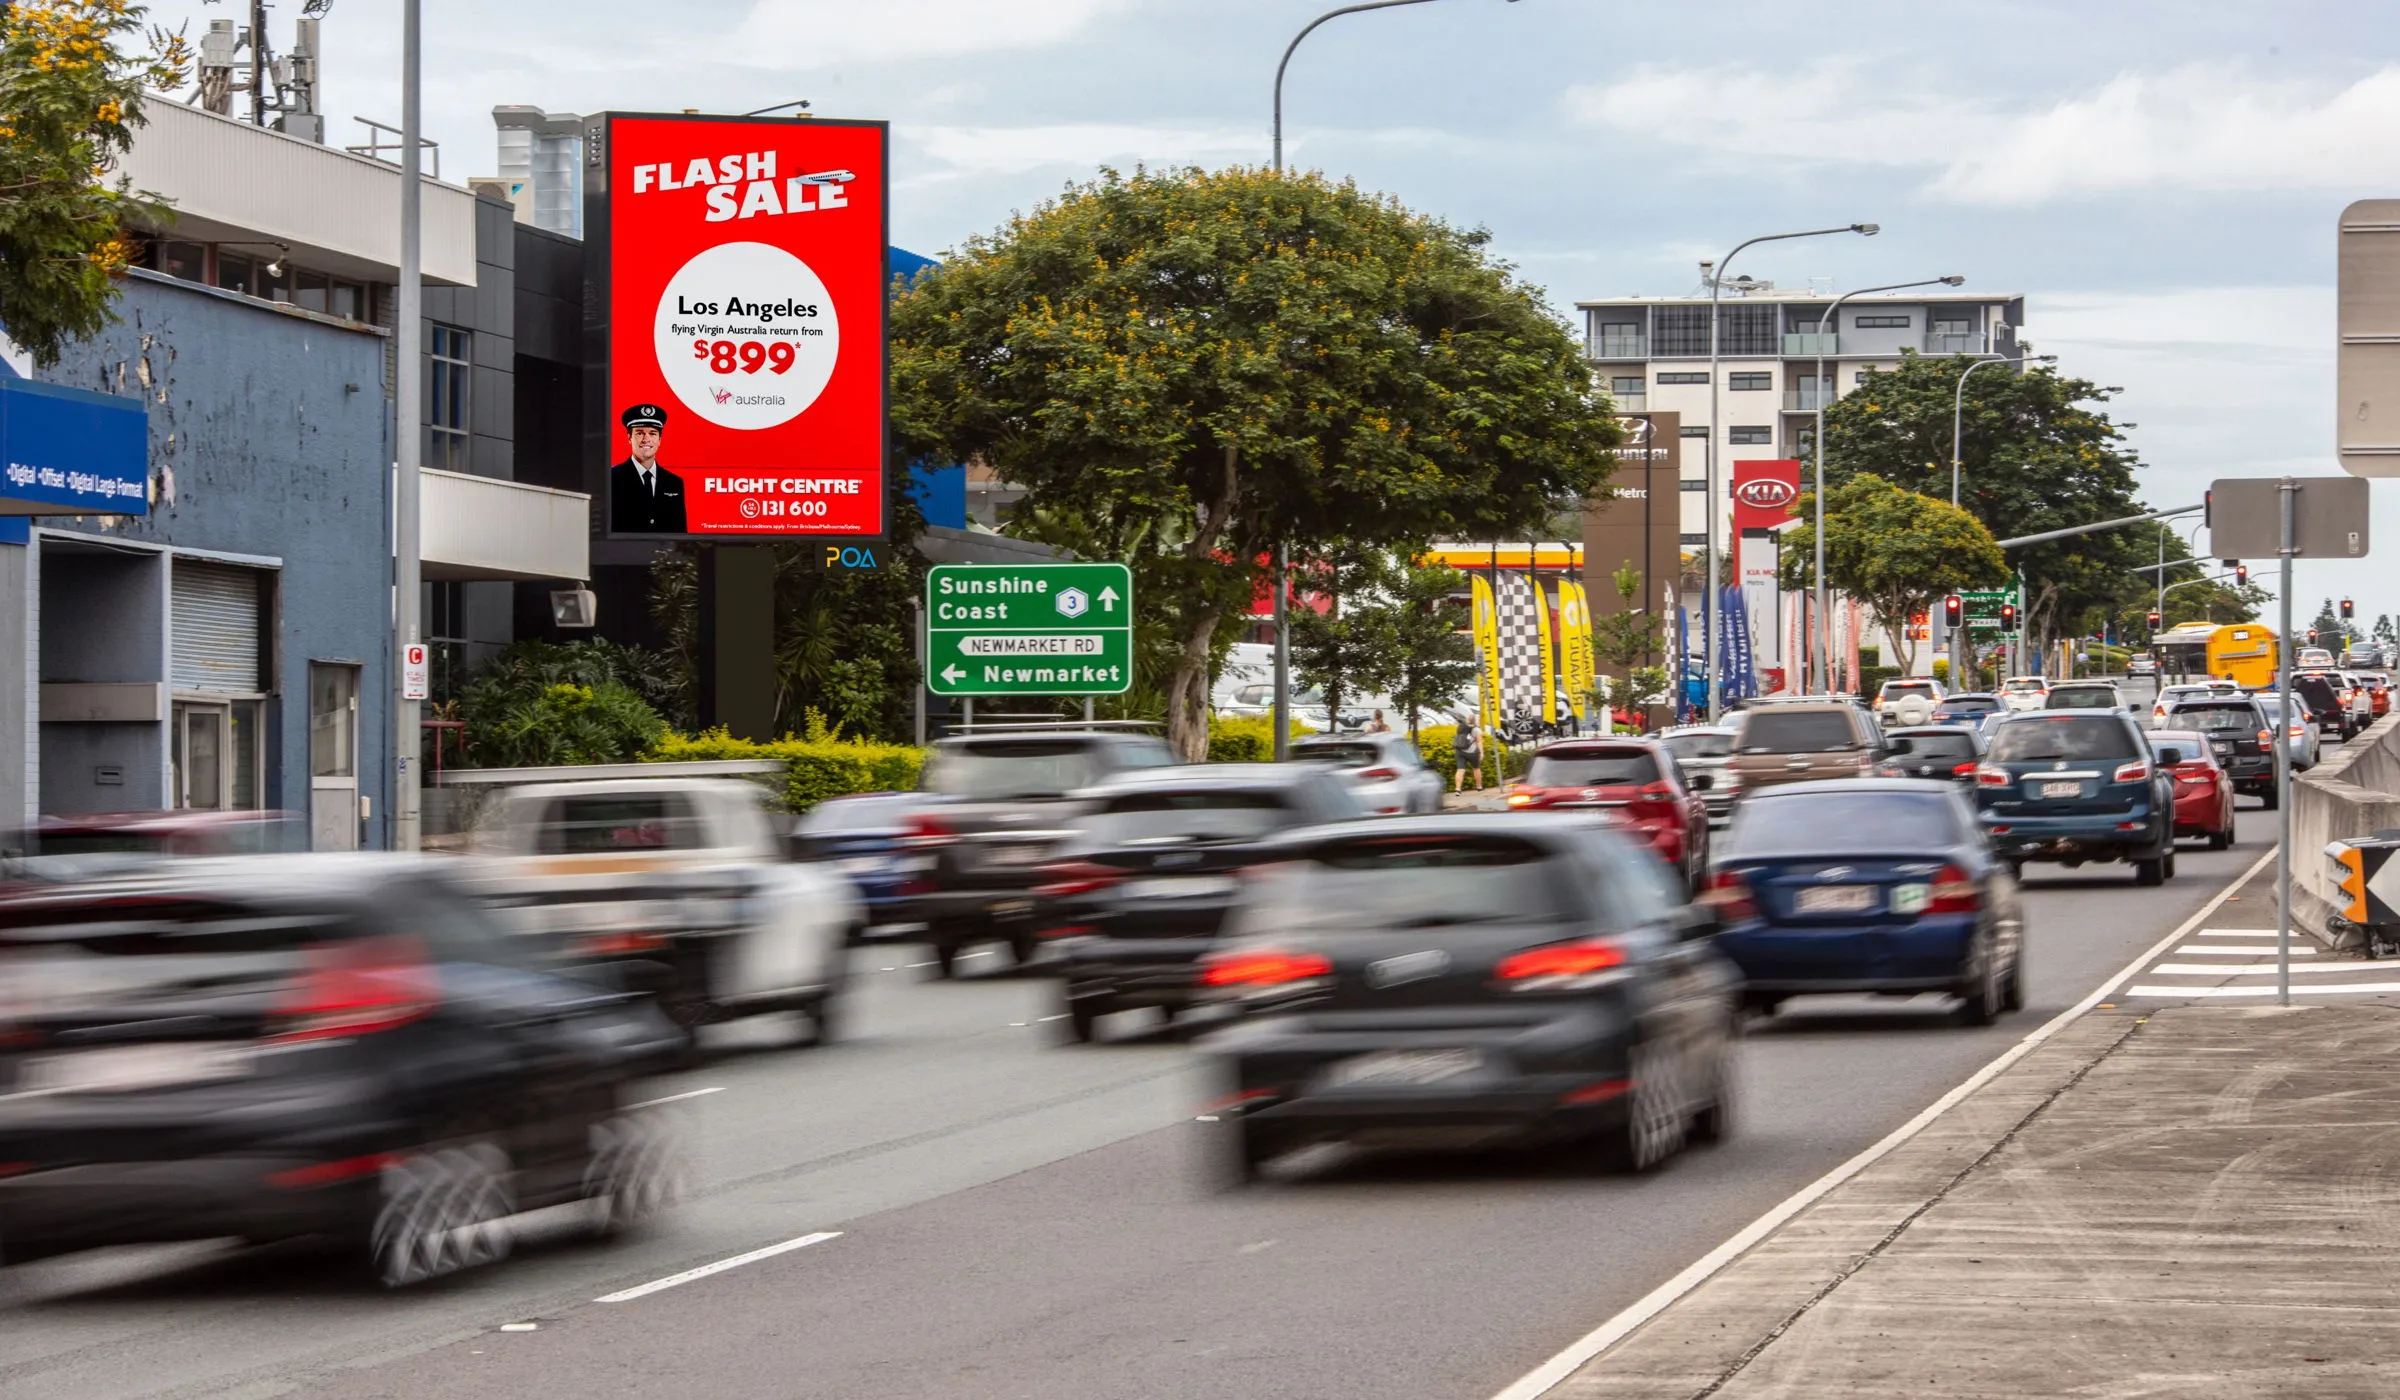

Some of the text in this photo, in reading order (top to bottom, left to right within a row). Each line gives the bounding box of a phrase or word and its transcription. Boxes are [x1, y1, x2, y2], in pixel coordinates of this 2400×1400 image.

[633, 150, 777, 194] FLASH
[704, 177, 849, 223] SALE
[678, 295, 818, 323] Los Angeles
[671, 323, 823, 337] flying Virgin Australia return from
[735, 394, 786, 406] australia
[704, 478, 778, 494] FLIGHT
[1747, 485, 1785, 500] KIA
[762, 501, 827, 517] 131 600
[826, 547, 877, 568] POA
[939, 576, 1048, 594] Sunshine
[938, 602, 1008, 620] Coast
[1067, 596, 1077, 609] 3
[971, 639, 1095, 653] NEWMARKET RD
[984, 665, 1120, 683] Newmarket
